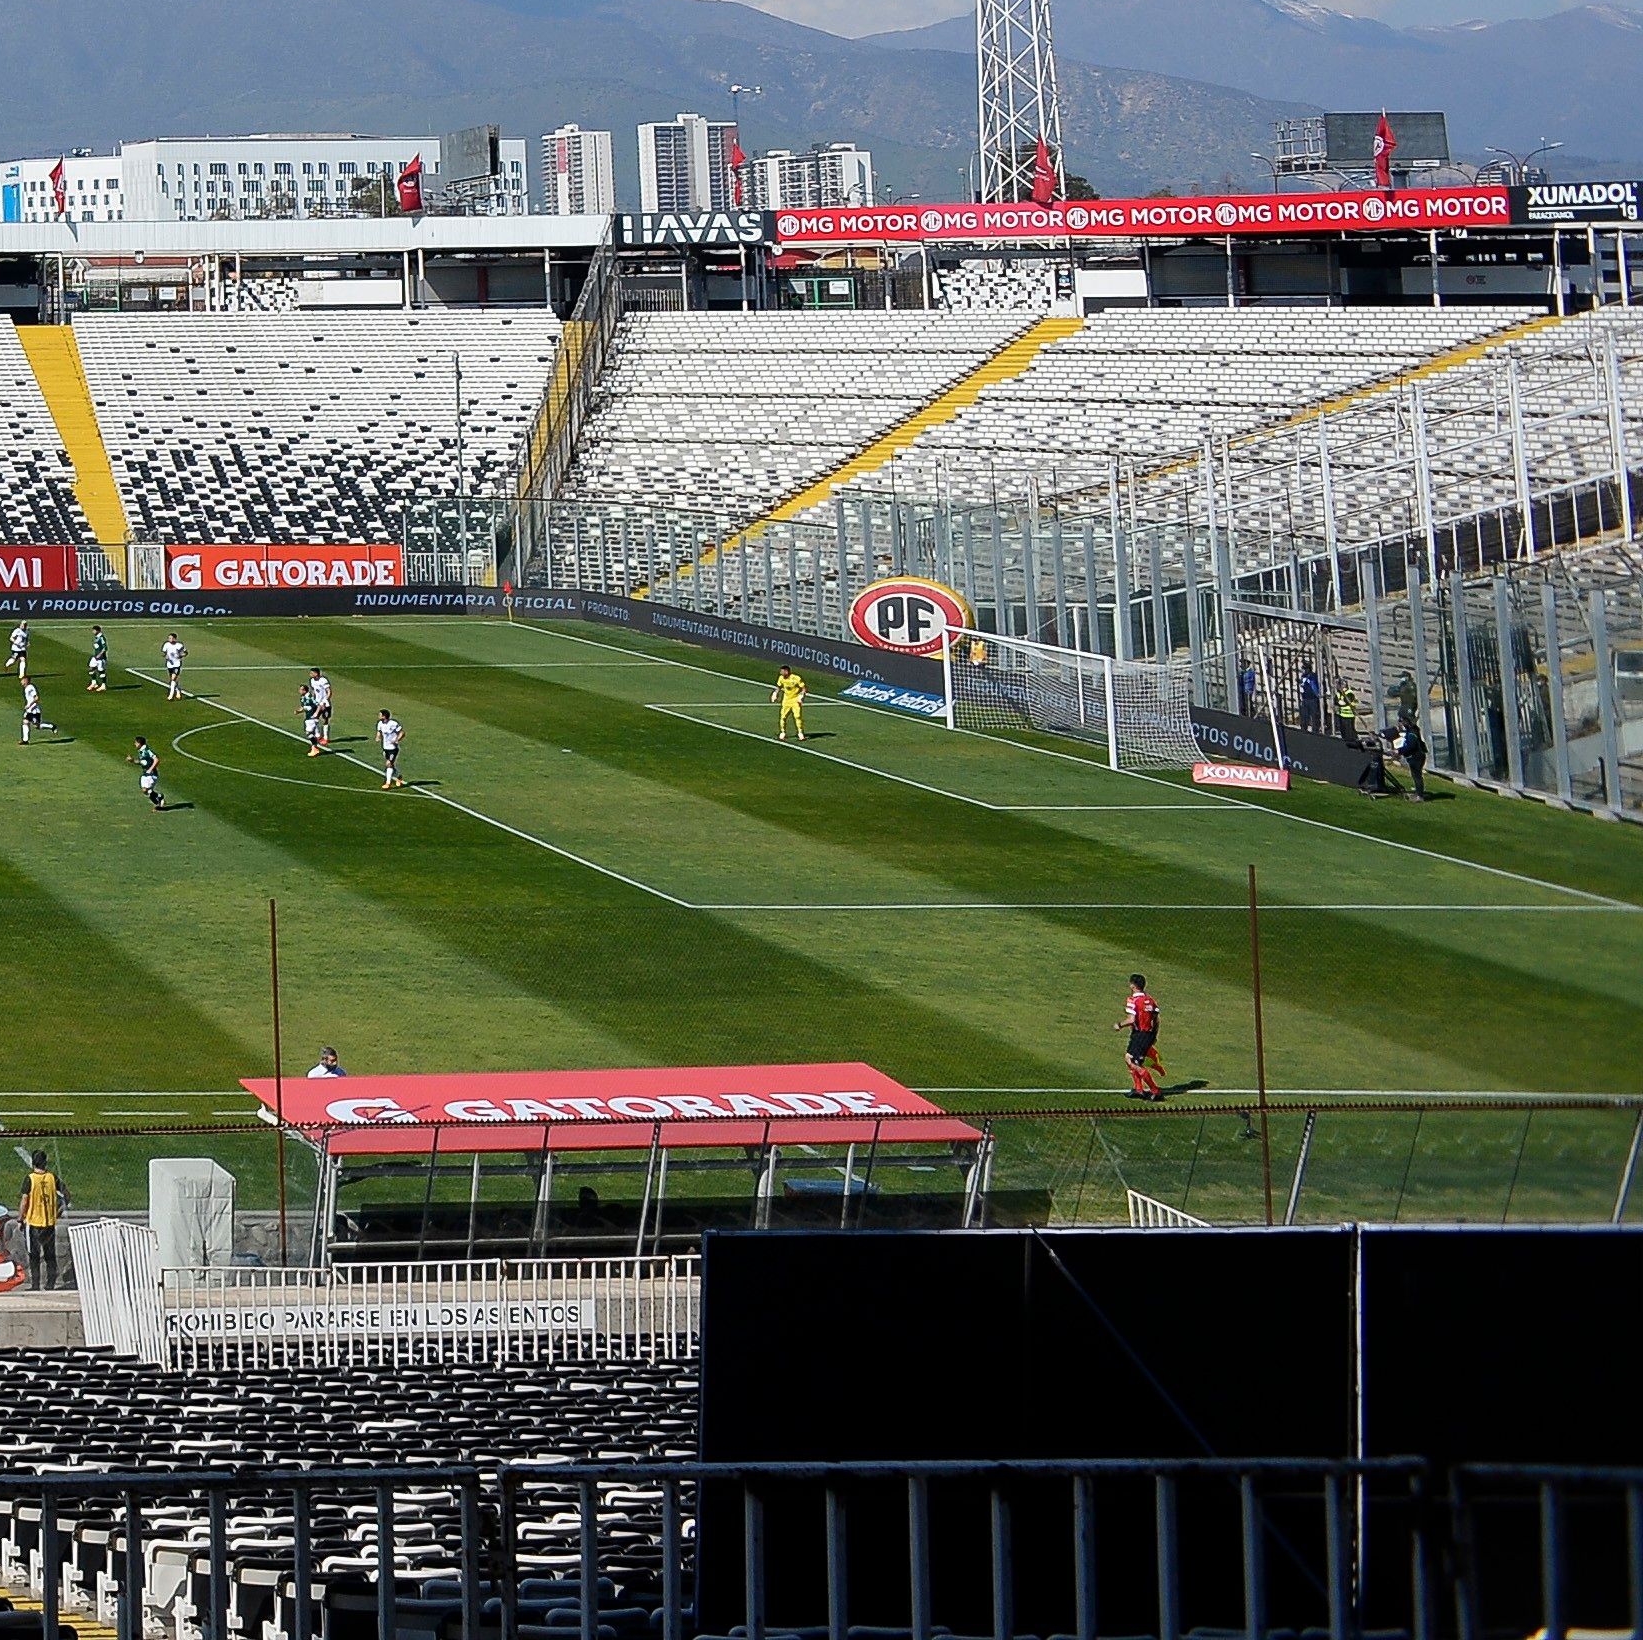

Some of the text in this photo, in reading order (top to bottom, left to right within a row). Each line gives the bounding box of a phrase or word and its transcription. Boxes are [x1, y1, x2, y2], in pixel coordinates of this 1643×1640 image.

[1527, 183, 1637, 205] XUMADOL
[1090, 209, 1124, 226] MG
[1131, 206, 1212, 225] MOTOR
[1238, 205, 1271, 223] MG
[1278, 202, 1359, 221] MOTOR
[1386, 199, 1419, 218] MG
[1426, 197, 1506, 216] MOTOR
[1619, 202, 1637, 220] 1g
[622, 214, 763, 244] HAVAS
[800, 216, 834, 233] MG
[840, 214, 917, 233] MOTOR
[944, 212, 977, 229] MG
[984, 210, 1063, 228] MOTOR
[169, 554, 395, 589] G GATORADE
[26, 600, 39, 612] Y
[587, 601, 629, 620] PRODUCTO
[877, 596, 935, 643] PF
[1203, 765, 1279, 784] KONAMI
[443, 1091, 898, 1123] GATORADE
[390, 1308, 417, 1327] EN
[426, 1307, 468, 1326] LOS
